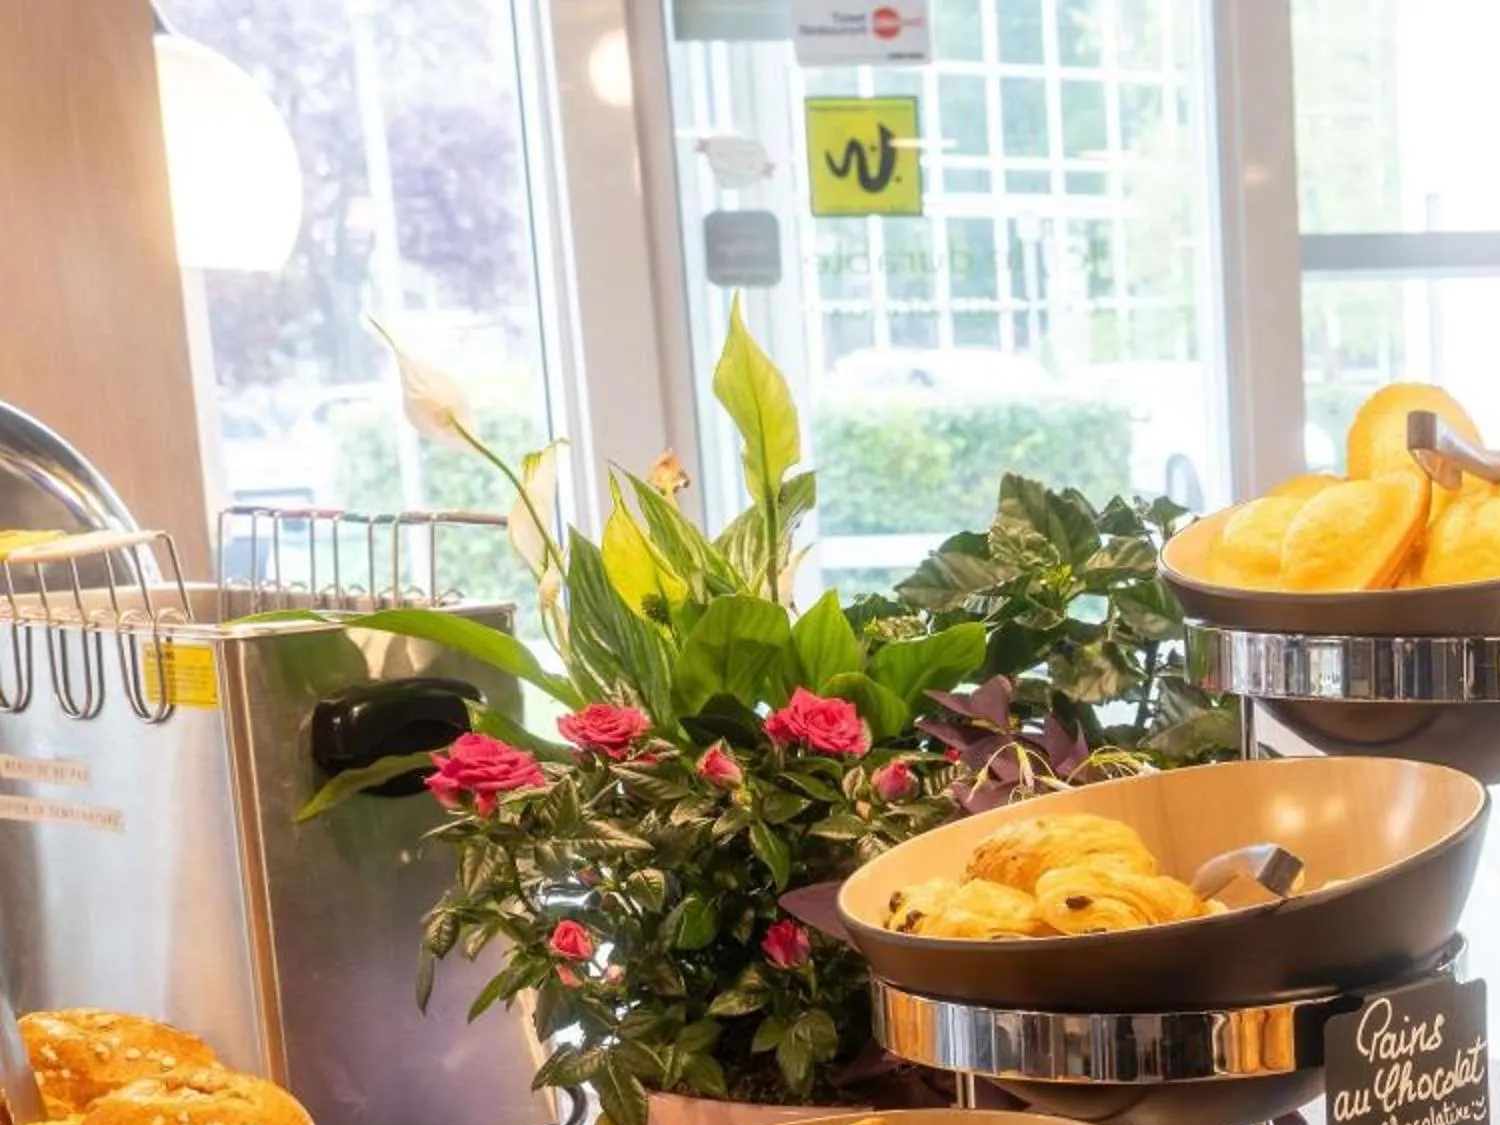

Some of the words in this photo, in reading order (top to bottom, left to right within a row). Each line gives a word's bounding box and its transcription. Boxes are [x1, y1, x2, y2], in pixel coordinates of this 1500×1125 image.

[1356, 997, 1445, 1062] Pains
[1334, 1086, 1371, 1122] au
[1374, 1035, 1486, 1112] Chocolat
